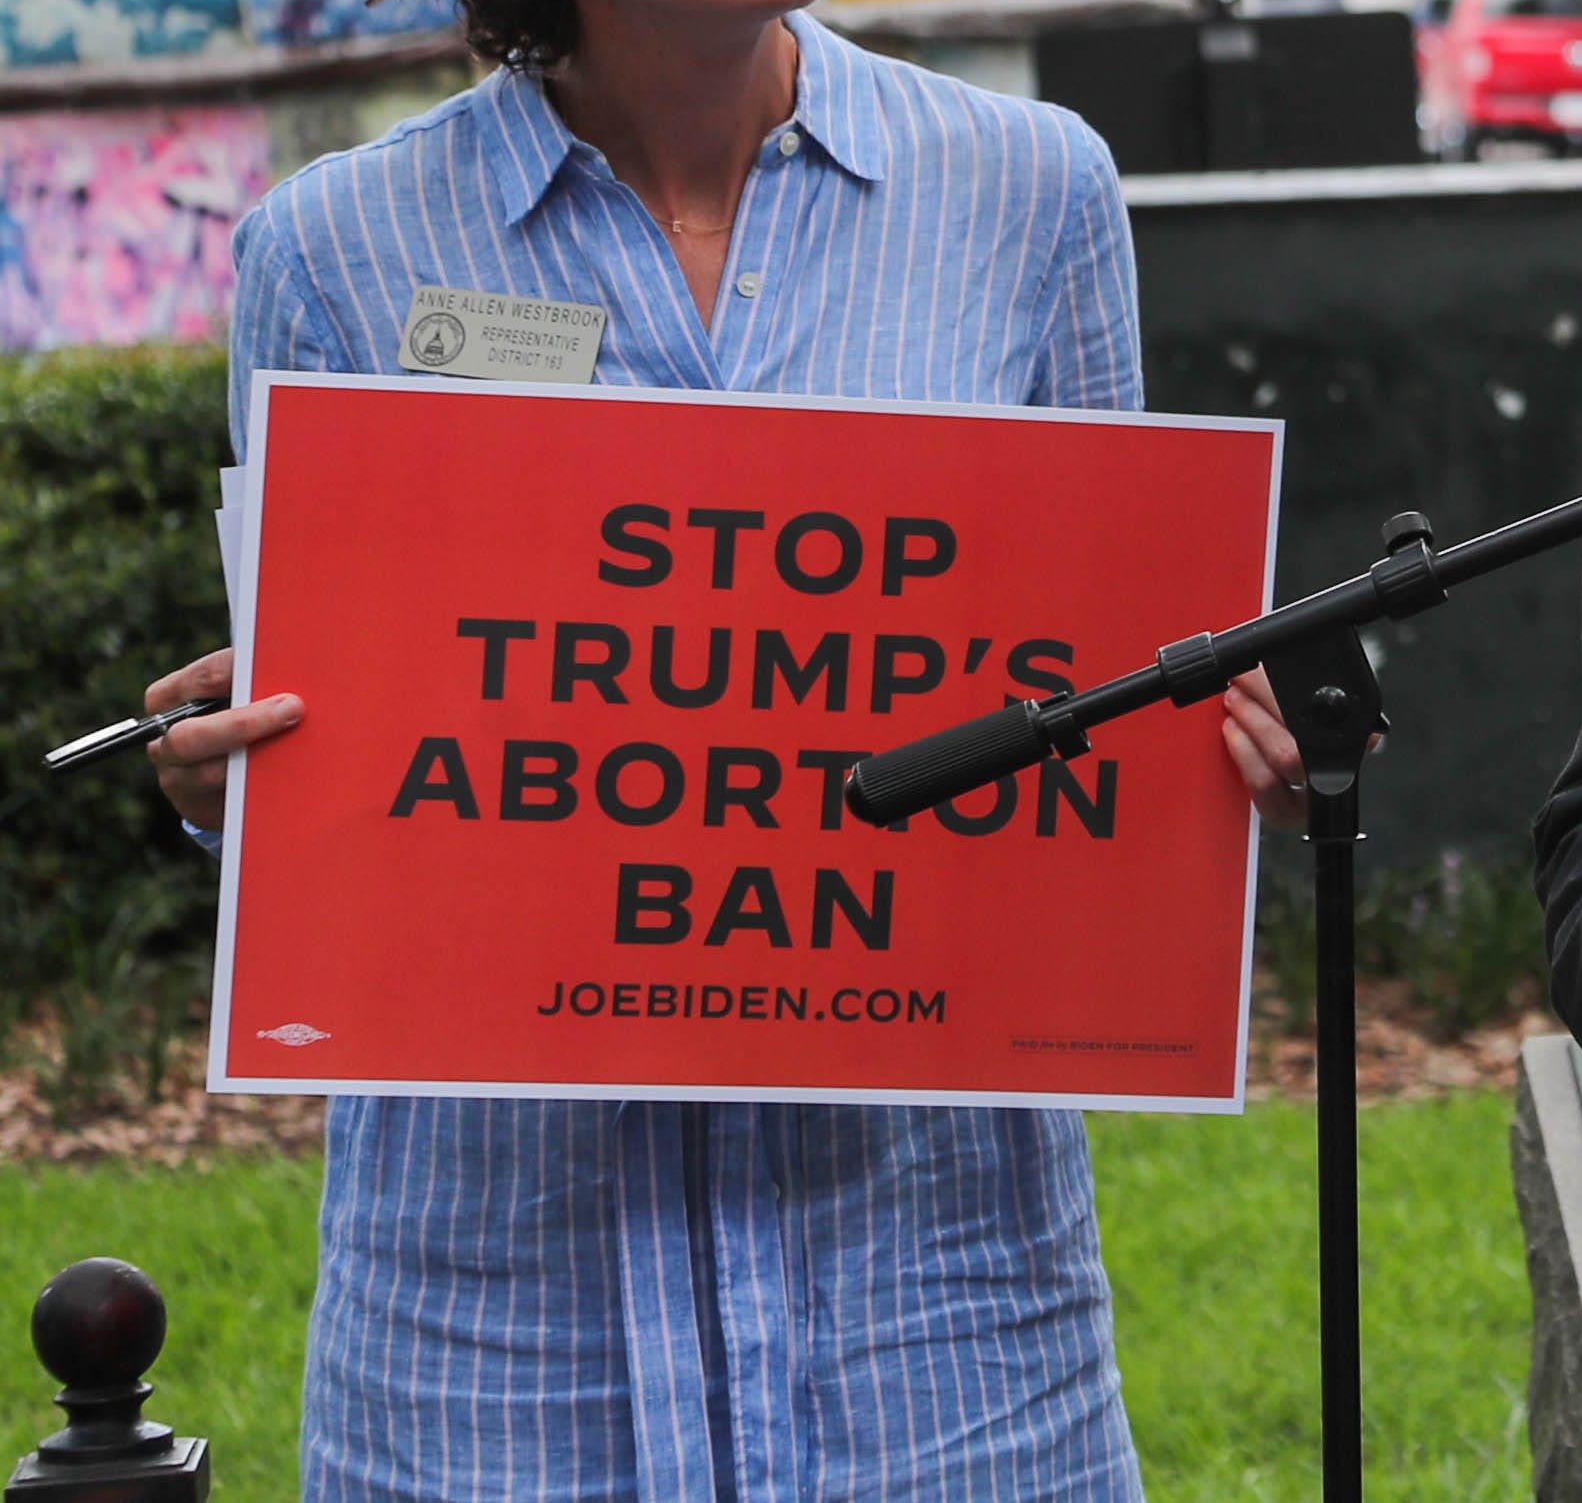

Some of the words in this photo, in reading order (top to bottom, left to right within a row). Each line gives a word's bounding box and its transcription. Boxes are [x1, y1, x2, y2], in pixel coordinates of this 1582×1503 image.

[416, 291, 456, 310] ANNE
[460, 297, 505, 316] ALLEN
[512, 302, 601, 328] WESTBROOK
[481, 326, 580, 351] REPRESENTATIVE
[488, 348, 540, 369] DISTRICT
[544, 355, 563, 370] 163
[598, 504, 958, 597] STOP
[457, 618, 1075, 715] TRUMP'S
[389, 738, 1118, 839] ABORTON
[615, 863, 894, 951] BAN
[537, 982, 947, 1024] JOEBIDEN.COM
